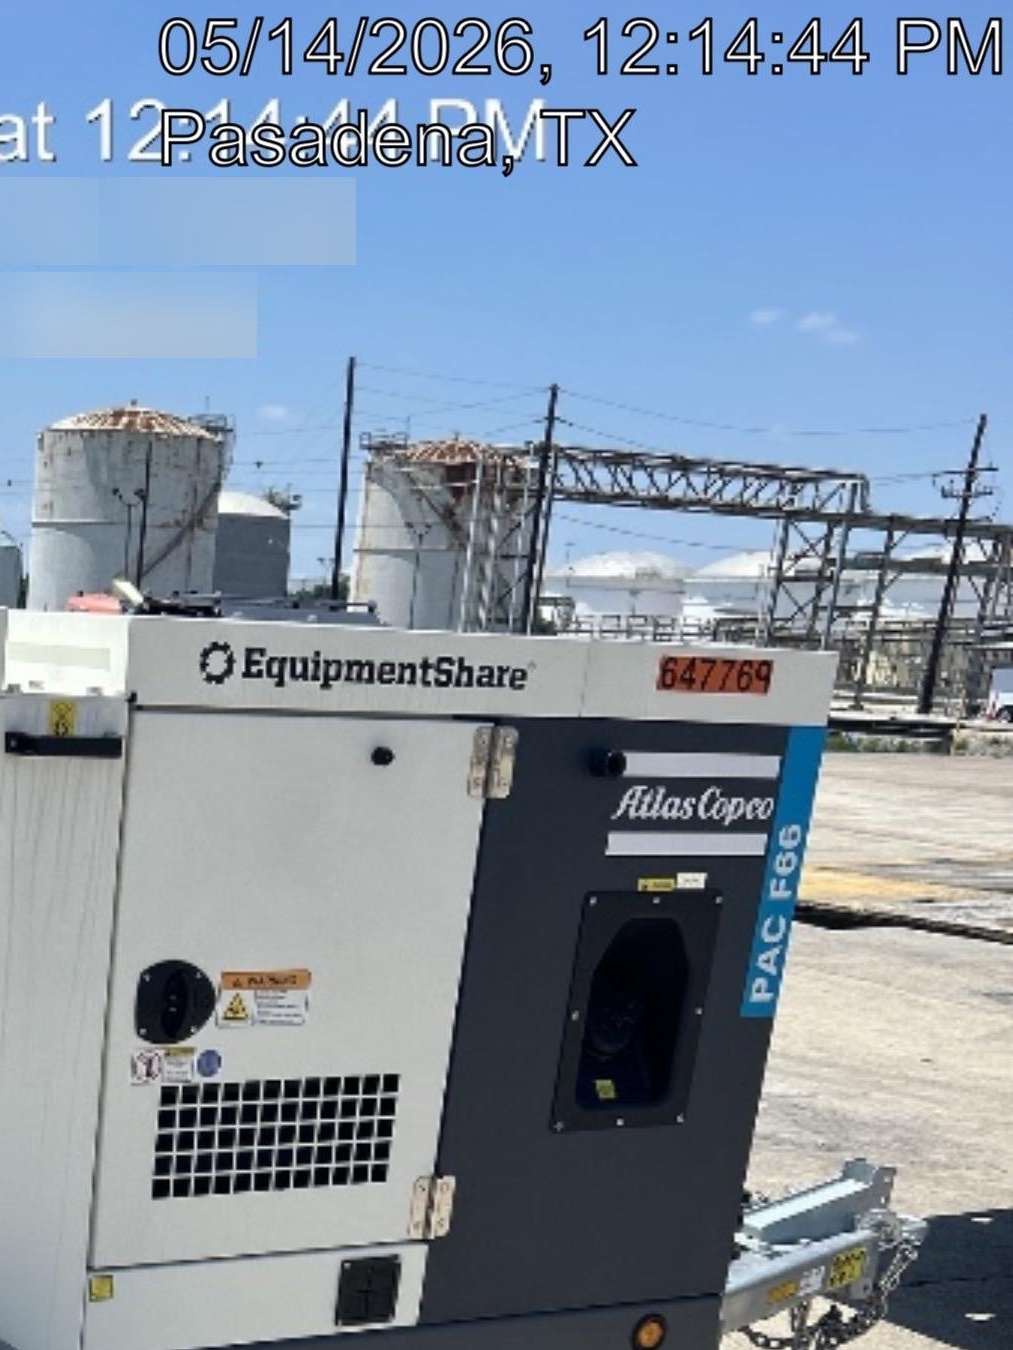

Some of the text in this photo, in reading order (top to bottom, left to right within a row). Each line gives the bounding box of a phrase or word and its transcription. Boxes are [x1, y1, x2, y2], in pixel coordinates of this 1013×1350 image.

[241, 647, 529, 691] EquipmentShare
[660, 655, 773, 694] 647769
[611, 785, 774, 826] Atlas Copco
[749, 915, 786, 1003] PAC
